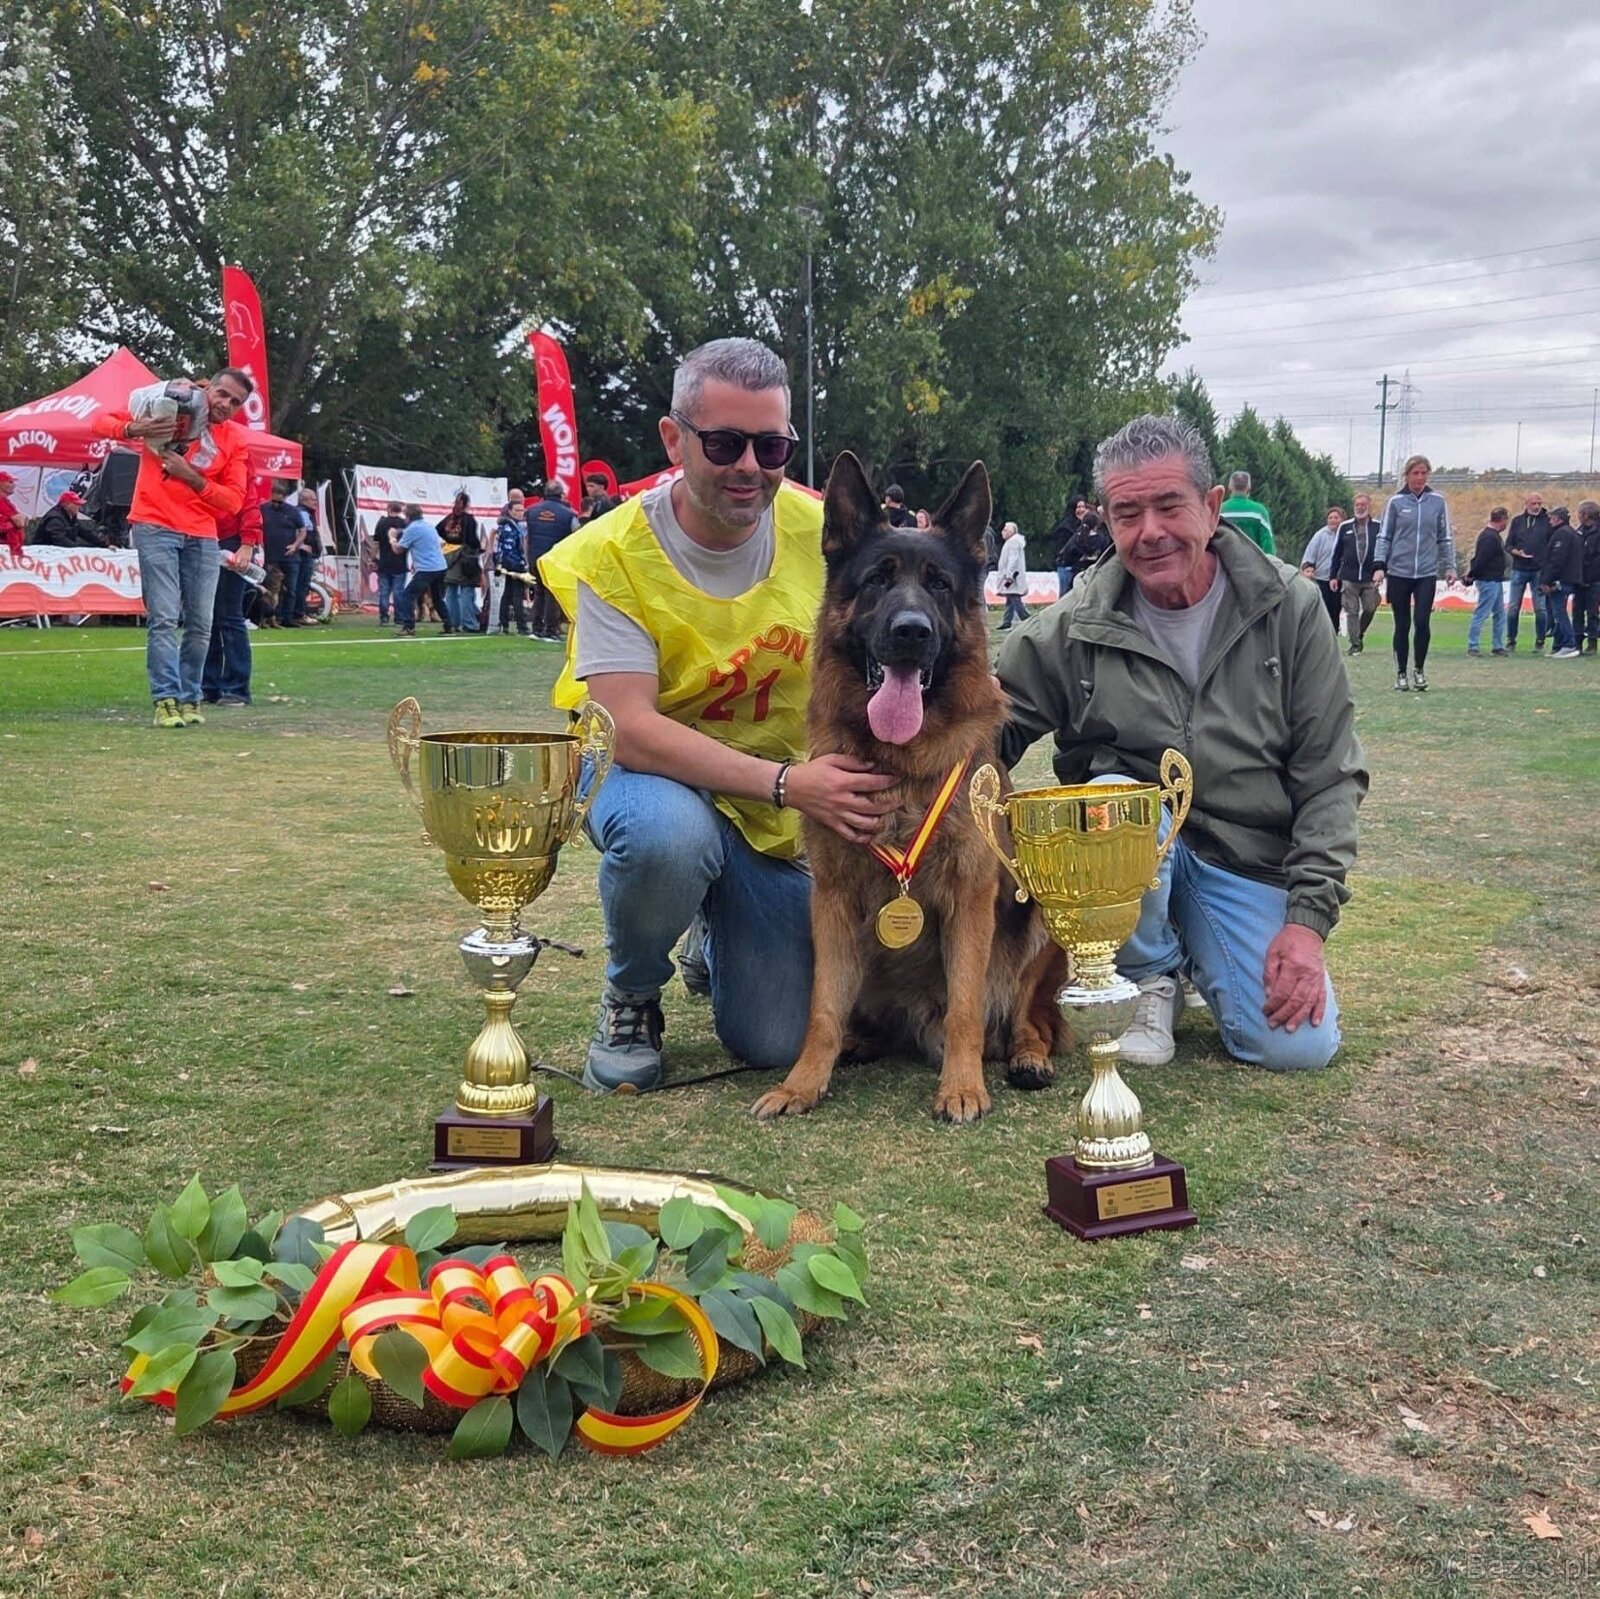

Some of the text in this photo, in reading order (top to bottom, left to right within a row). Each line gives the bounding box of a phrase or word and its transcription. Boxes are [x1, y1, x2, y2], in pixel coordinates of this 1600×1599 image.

[3, 395, 102, 422] ARION
[8, 430, 58, 457] ARION
[56, 555, 122, 586] ARION
[701, 667, 782, 722] 21
